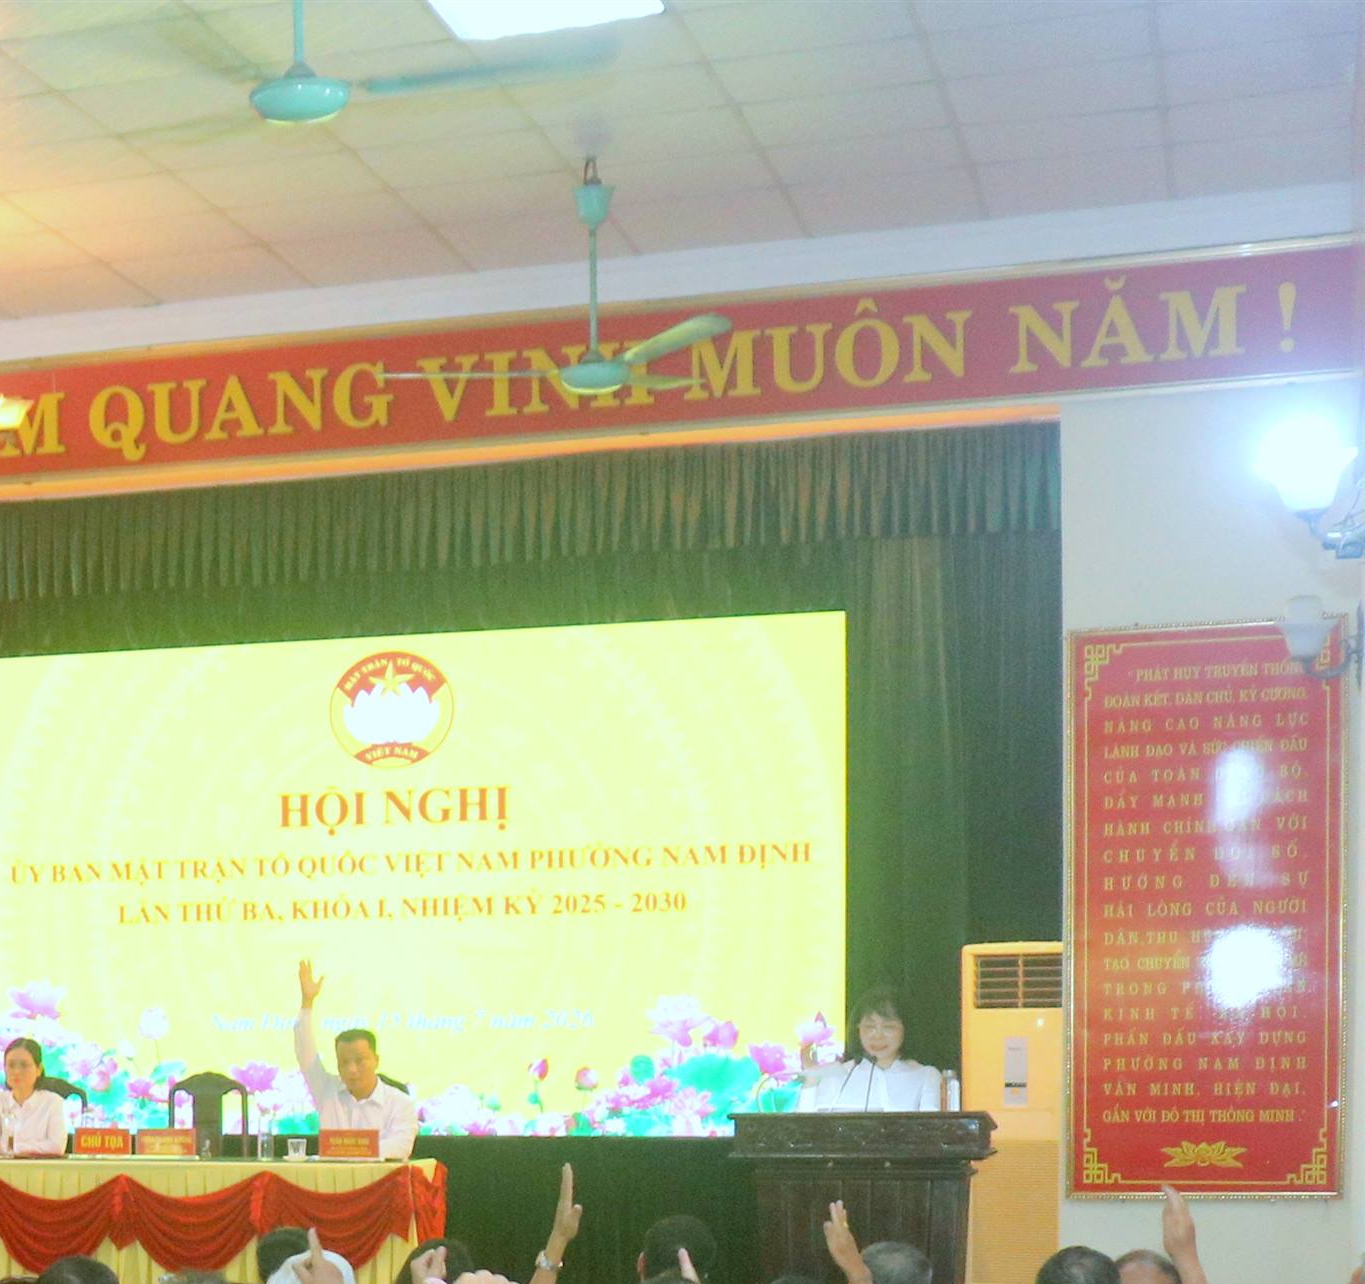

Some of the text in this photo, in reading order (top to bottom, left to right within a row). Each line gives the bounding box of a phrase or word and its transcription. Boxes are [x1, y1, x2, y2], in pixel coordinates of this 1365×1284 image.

[88, 360, 395, 463] QUANG
[682, 297, 994, 401] MUÔN
[1009, 275, 1247, 374] NĂM
[1277, 283, 1299, 354] !
[1173, 666, 1201, 679] HUY
[1166, 717, 1199, 730] CAO
[1145, 744, 1172, 758] ĐẠO
[1179, 740, 1196, 755] VÀ
[1104, 764, 1137, 783] CỦA
[1152, 765, 1201, 782] TOÀN
[279, 785, 510, 837] HỘI NGHỊ
[1104, 819, 1150, 836] HÀNH
[1277, 813, 1307, 830] VỚI
[1104, 839, 1196, 863] CHUYỂN
[52, 862, 102, 883] BAN
[175, 855, 246, 884] TRẬN
[384, 848, 446, 880] VIỆT
[458, 850, 520, 872] NAM
[530, 842, 653, 871] PHƯỜNG
[663, 845, 728, 867] NAM
[737, 842, 812, 871] ĐỊNH
[1104, 873, 1183, 891] HƯỚNG
[402, 893, 494, 923] NHIỆM
[552, 893, 607, 915] 2025
[631, 892, 687, 913] 2030
[1148, 899, 1192, 917] LÒNG
[1205, 896, 1239, 915] CỦA
[1253, 897, 1307, 914] NGƯỜI
[1103, 983, 1167, 995] TRONG
[1104, 1007, 1155, 1021] KINH
[1104, 1027, 1149, 1045] PHẤN
[1163, 1026, 1197, 1045] ĐẤU
[1259, 1030, 1307, 1046] DỰNG
[1103, 1054, 1308, 1072] PHƯỜNG NAM ĐỊNH
[1214, 1078, 1256, 1099] HIỆN
